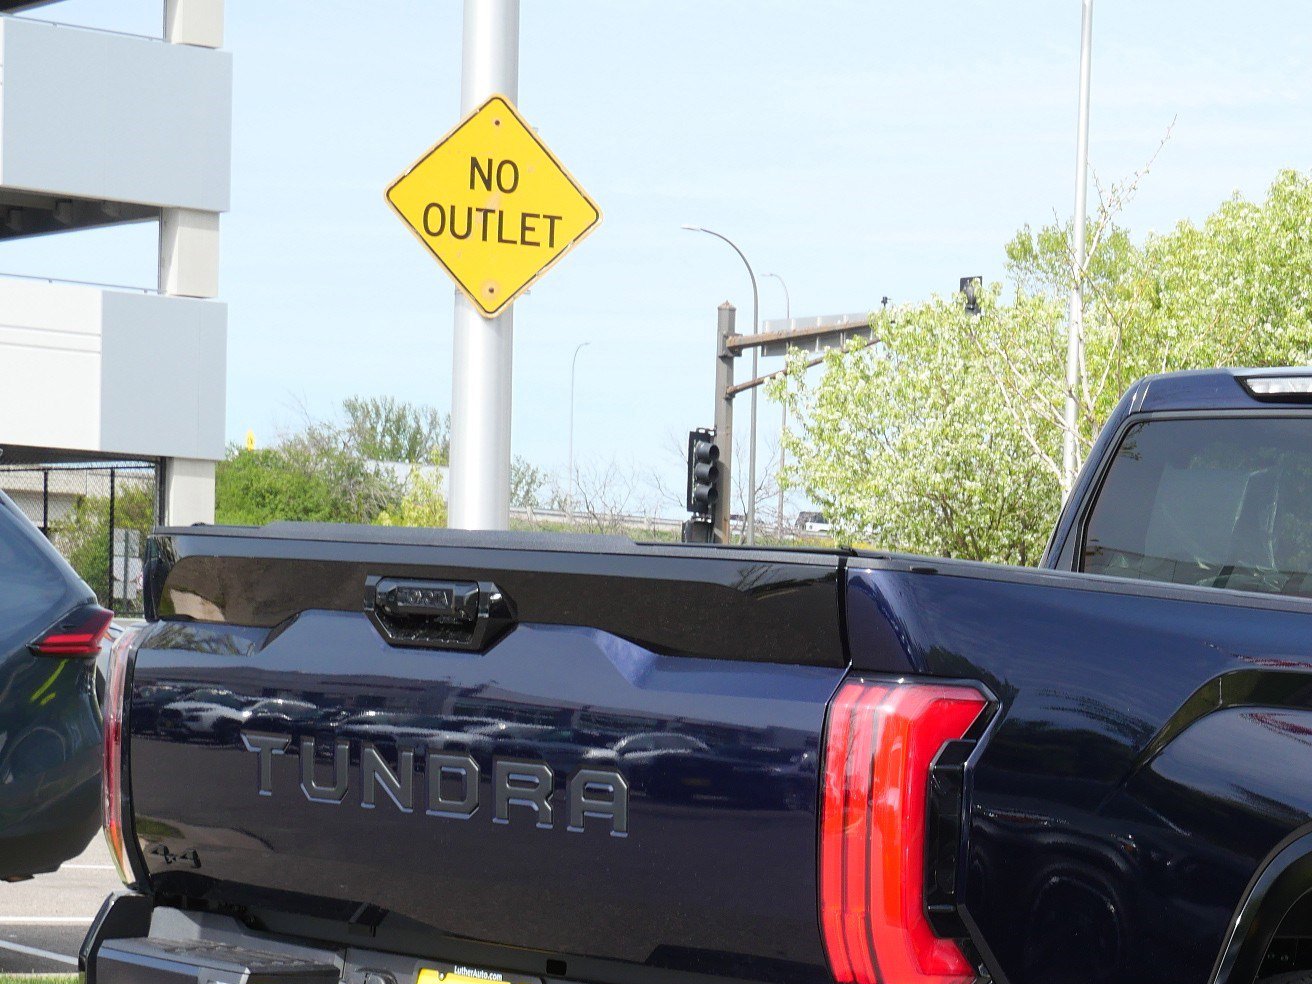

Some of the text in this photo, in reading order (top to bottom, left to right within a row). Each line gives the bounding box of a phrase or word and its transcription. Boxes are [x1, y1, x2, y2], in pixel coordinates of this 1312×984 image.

[469, 156, 519, 194] NO
[422, 202, 563, 249] OUTLET
[240, 730, 630, 838] TUNDRA
[454, 965, 503, 982] LutherAuto.com
